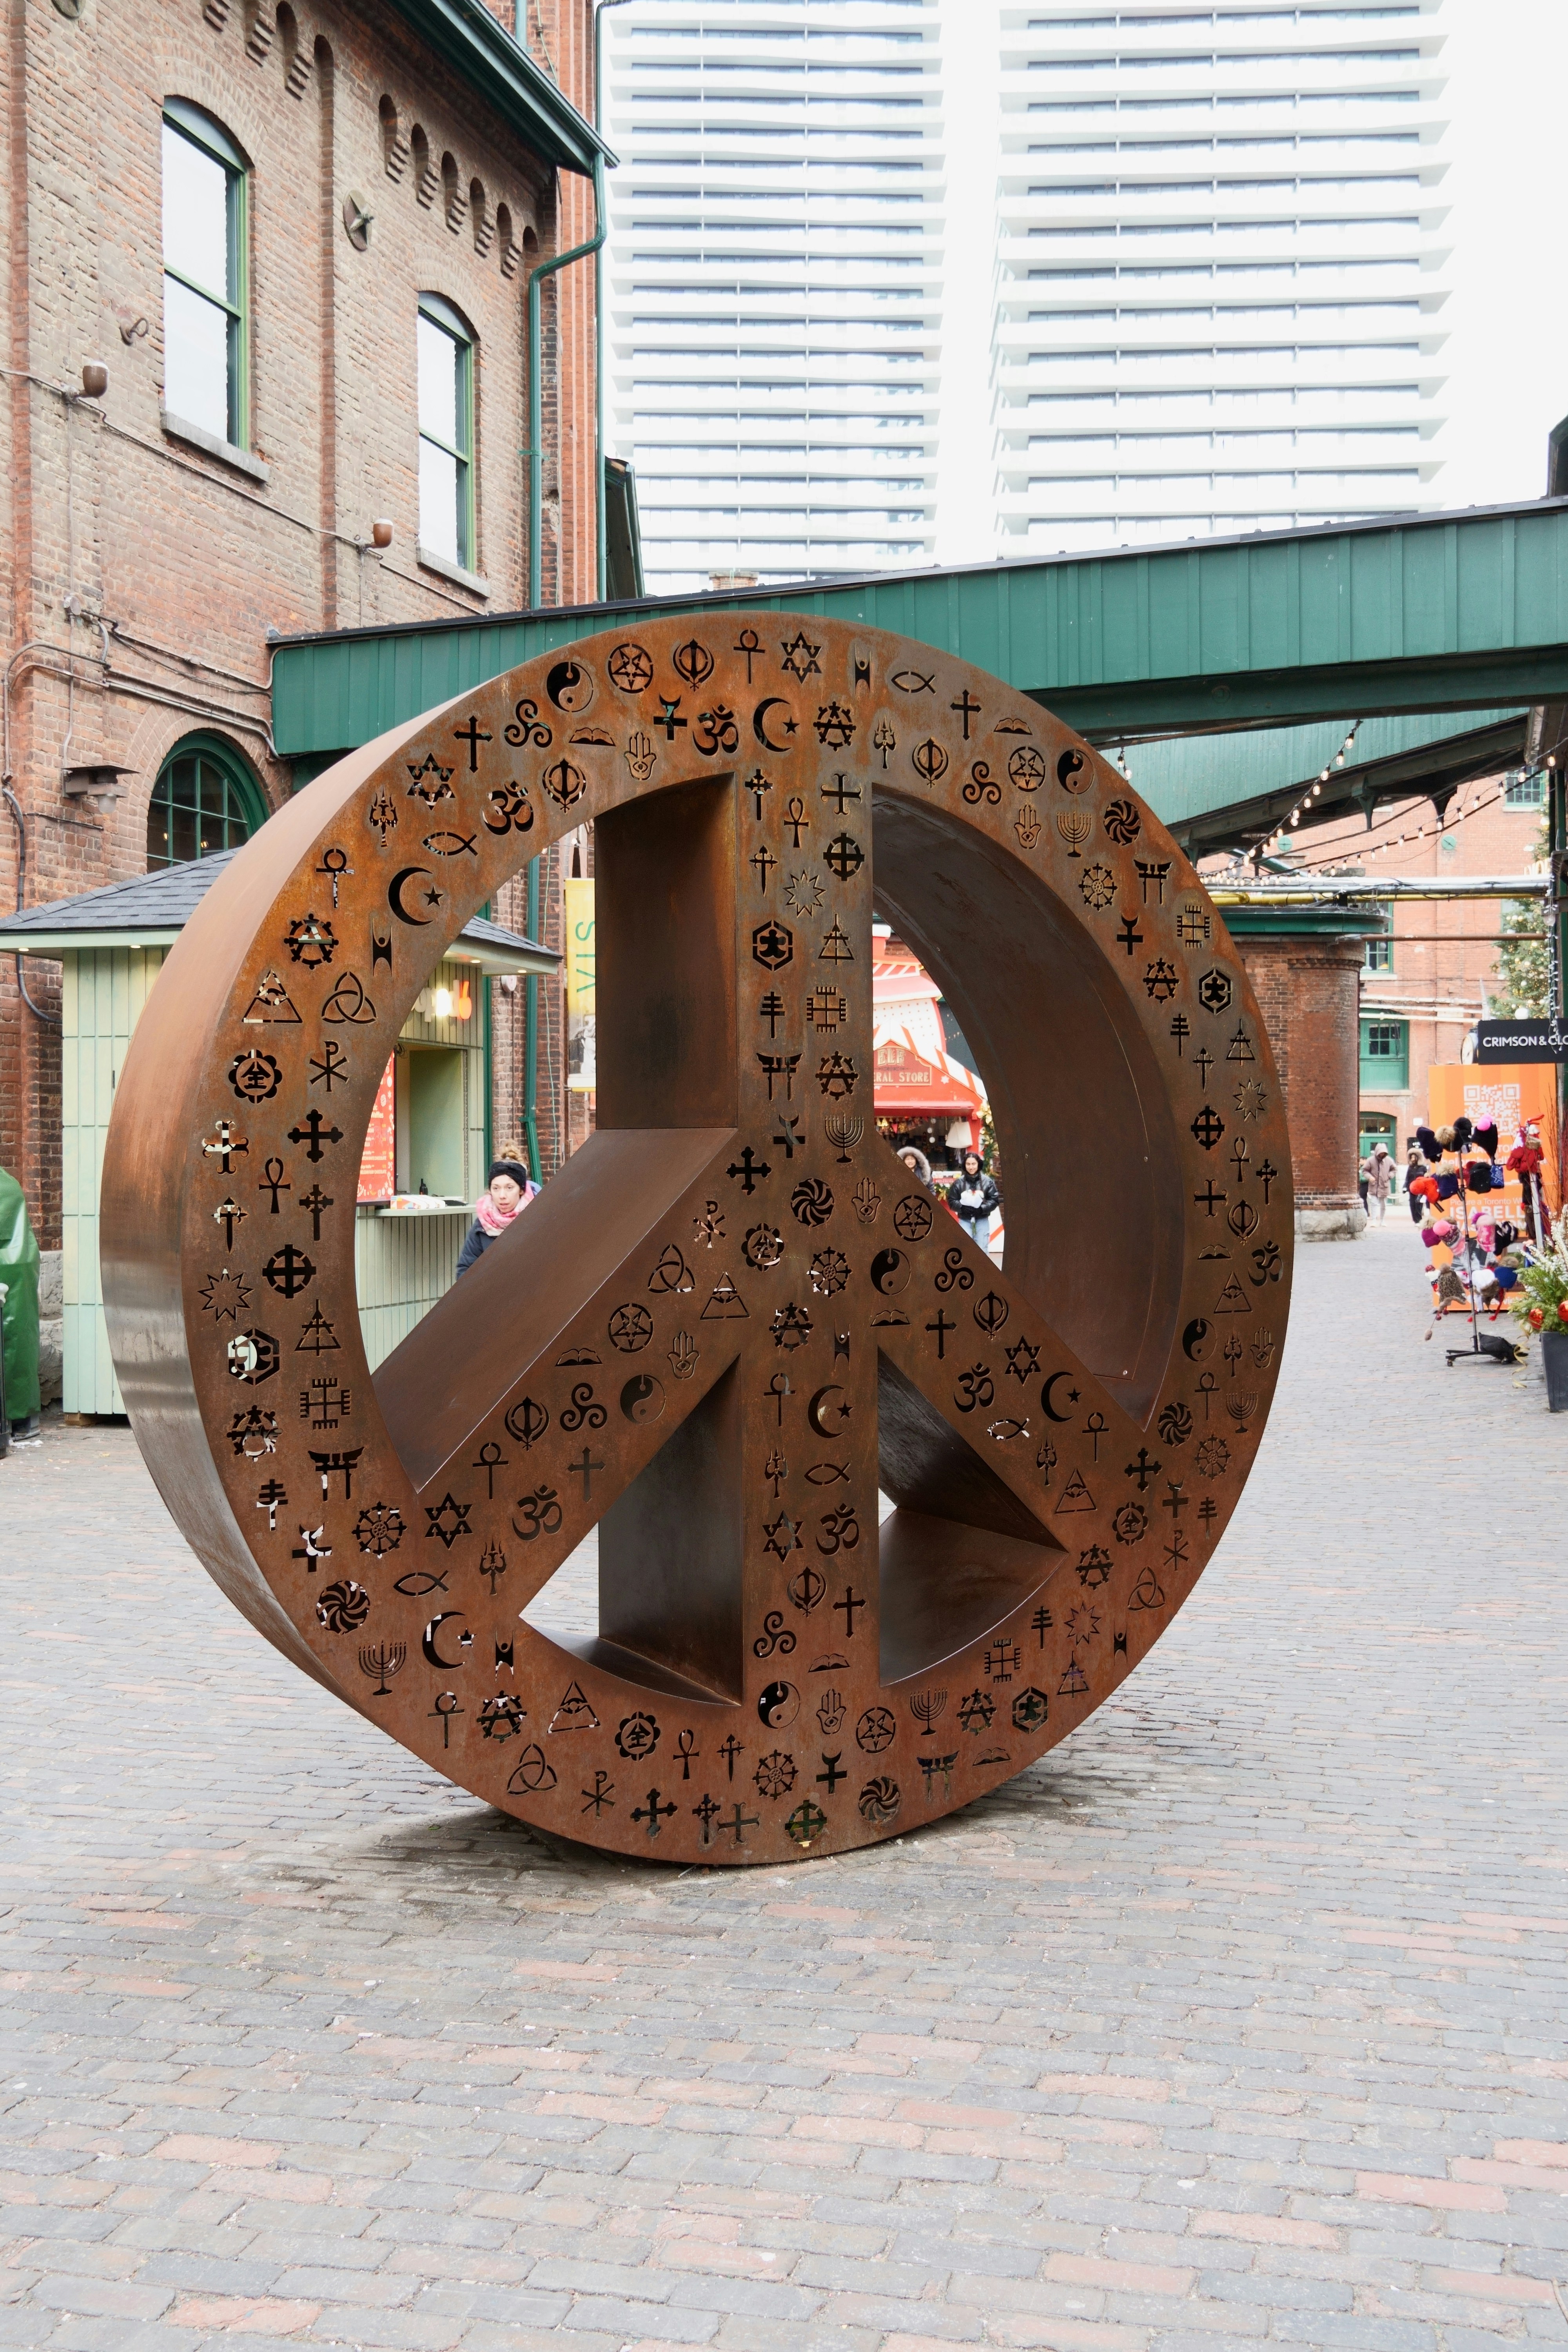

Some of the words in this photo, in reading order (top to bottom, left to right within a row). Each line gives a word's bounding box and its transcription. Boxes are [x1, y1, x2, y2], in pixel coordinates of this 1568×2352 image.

[1483, 1036, 1537, 1047] CRIMSON
[1539, 1035, 1547, 1046] &
[899, 1071, 929, 1083] STORE
